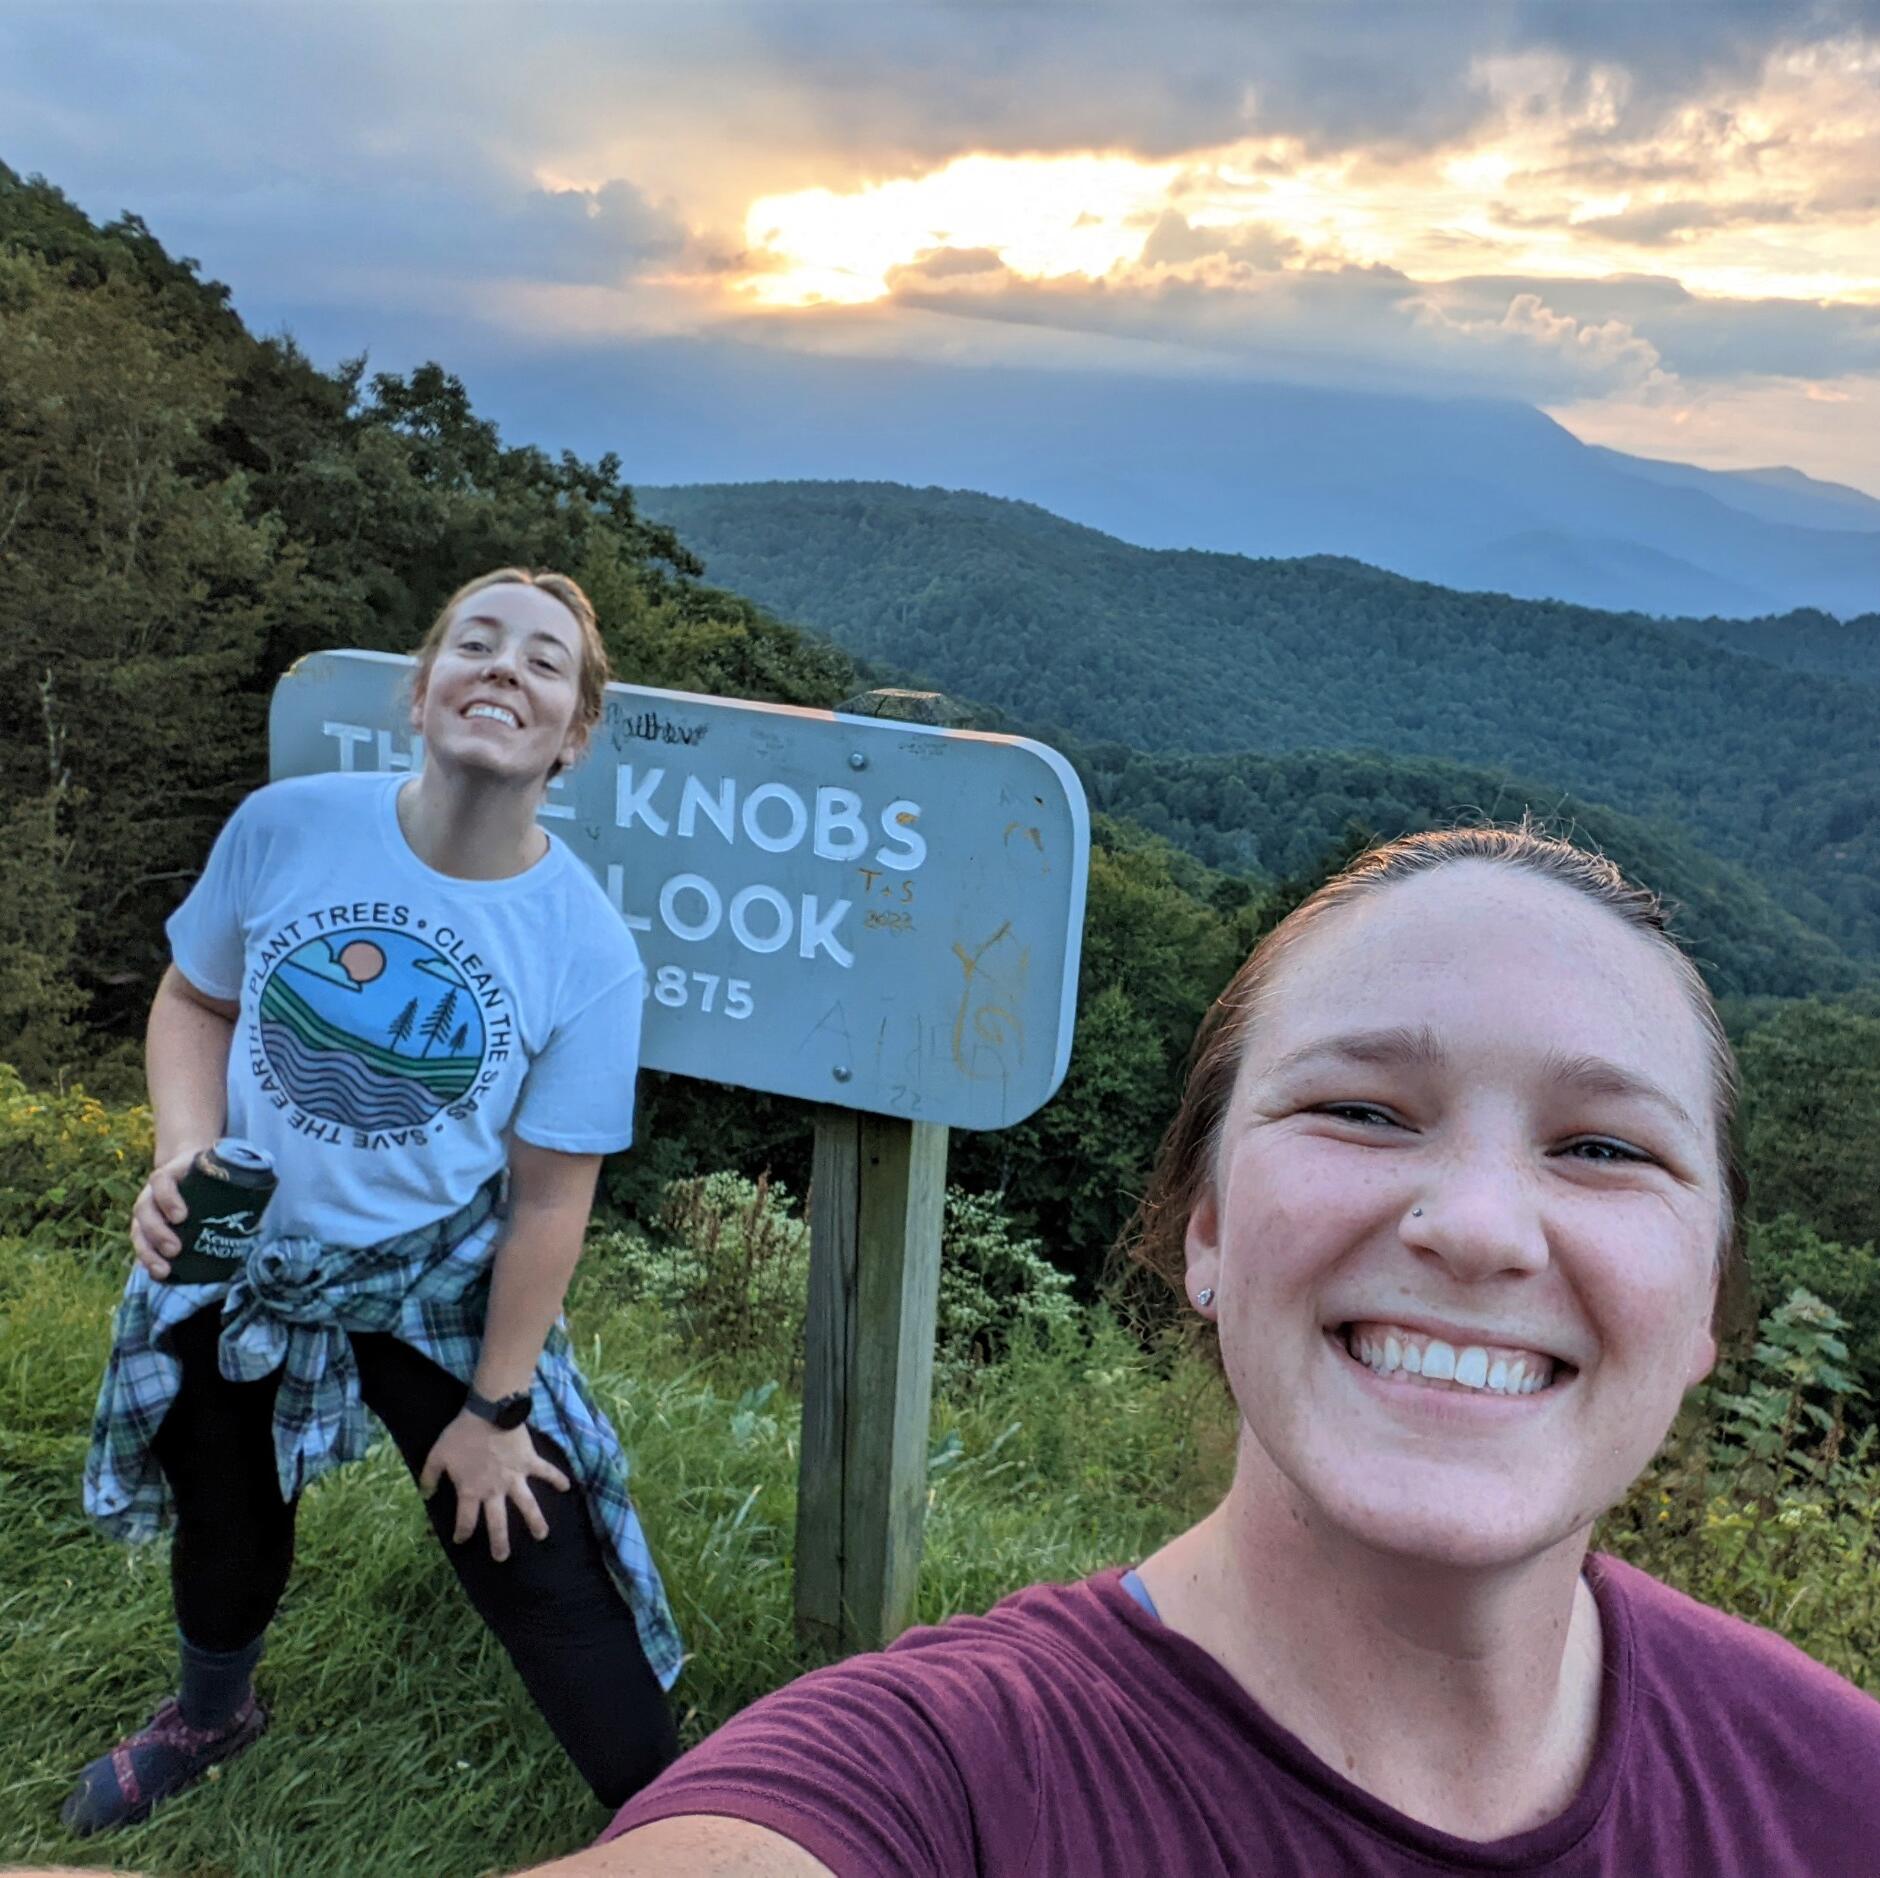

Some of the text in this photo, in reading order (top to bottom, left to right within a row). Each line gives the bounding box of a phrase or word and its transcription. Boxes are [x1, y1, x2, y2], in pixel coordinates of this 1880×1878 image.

[615, 763, 927, 871] KNOBS
[308, 902, 410, 931] TREES
[607, 863, 855, 969] LOOK
[250, 920, 303, 996] PLANT
[434, 926, 506, 1010] CLEAN
[641, 965, 754, 1020] 875
[248, 1023, 290, 1111] EARTH
[489, 1013, 512, 1063] THE
[288, 1111, 343, 1148] THE
[352, 1125, 429, 1151] SAVE
